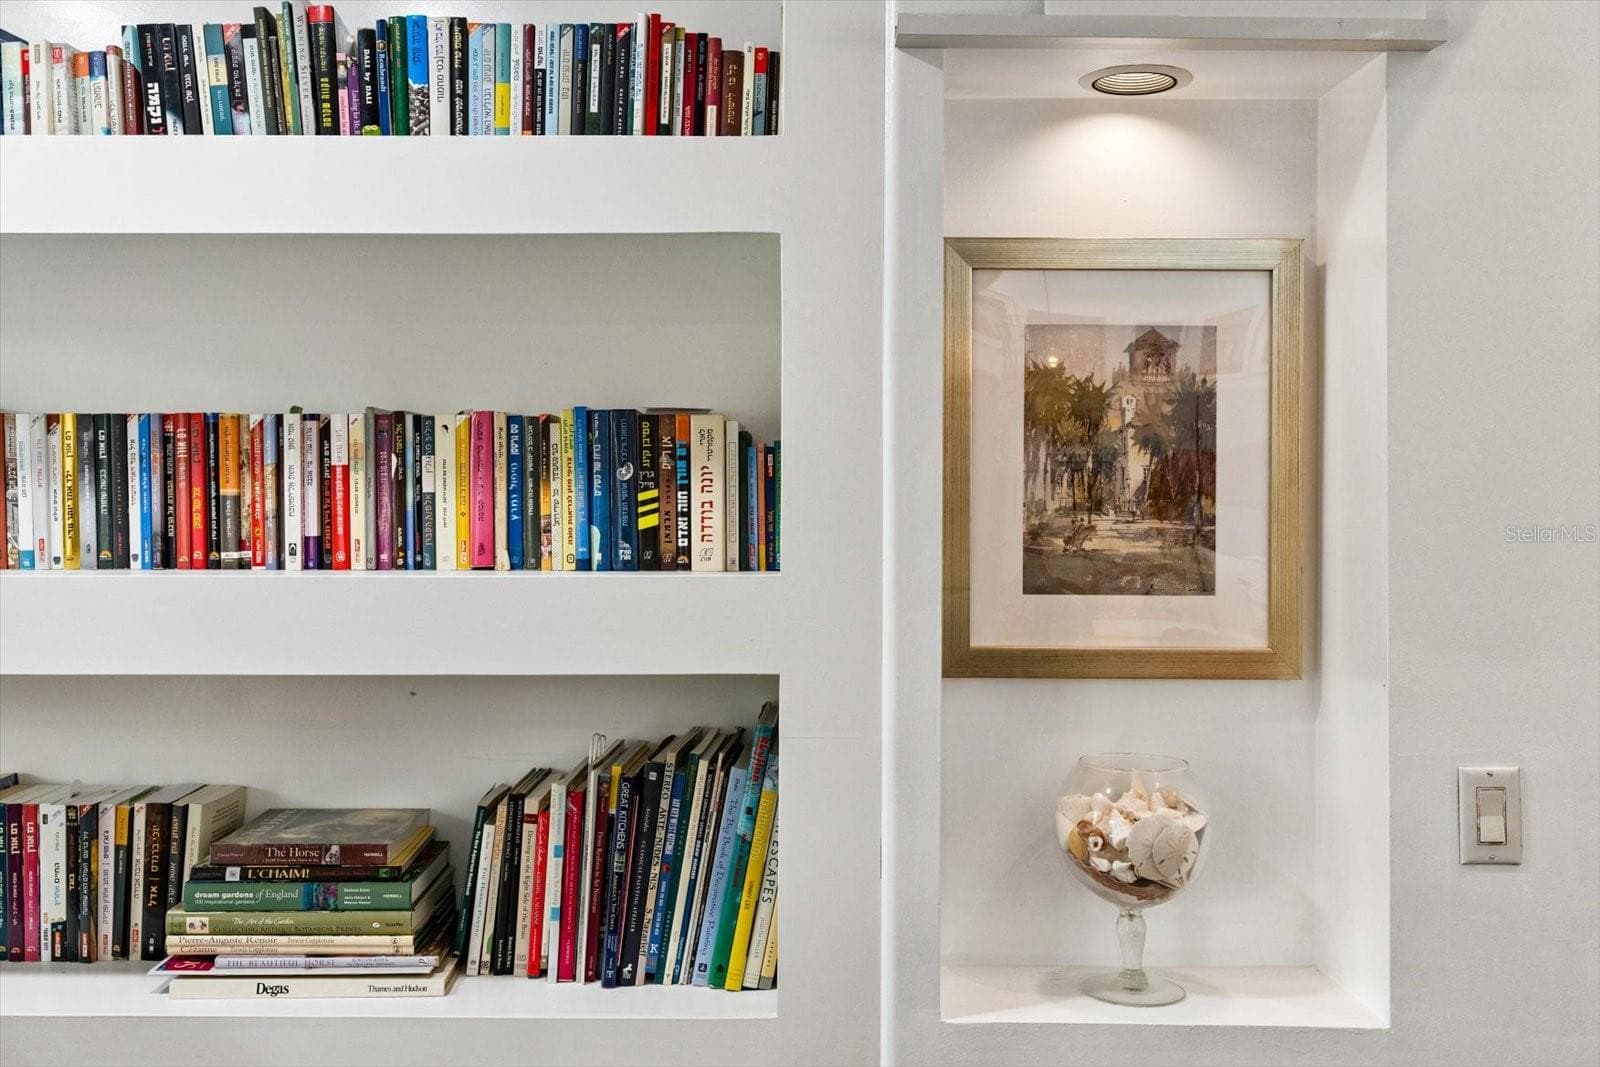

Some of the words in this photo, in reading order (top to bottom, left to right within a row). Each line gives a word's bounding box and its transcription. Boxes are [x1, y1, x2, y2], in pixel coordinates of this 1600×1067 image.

[164, 53, 175, 71] אורן
[300, 66, 308, 99] SILVER
[185, 90, 194, 103] שלך
[66, 431, 71, 441] רם
[99, 430, 105, 440] רם
[178, 428, 187, 439] רם
[662, 436, 672, 447] אן
[178, 441, 188, 458] אורן
[676, 442, 686, 456] רם
[593, 461, 601, 472] של
[642, 450, 651, 467] קינג
[662, 450, 672, 469] רייס
[509, 463, 518, 490] טיפול
[639, 471, 654, 480] גרין
[677, 461, 688, 485] אורן
[700, 466, 713, 493] יונה
[593, 475, 602, 496] כסילים
[510, 494, 520, 520] נמרץ
[677, 492, 688, 512] חוה
[700, 500, 713, 542] בודדה
[677, 518, 688, 547] ואדם
[661, 762, 674, 800] STEREO
[620, 782, 630, 808] GREAT
[728, 799, 738, 816] The
[10, 820, 17, 833] רם
[656, 808, 667, 829] AKTE
[670, 818, 678, 832] WEST
[726, 818, 735, 833] Big
[28, 822, 34, 833] רם
[616, 810, 627, 849] KITCHENS
[10, 837, 20, 854] אורן
[27, 837, 35, 852] אורן
[265, 847, 286, 857] The
[289, 847, 320, 857] Horse
[652, 837, 664, 866] NUDES
[664, 833, 676, 855] KITCHEN
[722, 836, 733, 857] Book
[247, 868, 309, 879] L'CHAIM!
[690, 859, 698, 879] HORSES
[650, 873, 658, 890] NUS
[148, 886, 157, 906] אדל
[255, 889, 263, 900] of
[265, 889, 298, 900] England
[710, 871, 726, 918] Decorative
[179, 937, 244, 945] Pierre-Auguste
[701, 921, 715, 955] Painting
[256, 982, 289, 996] Degas
